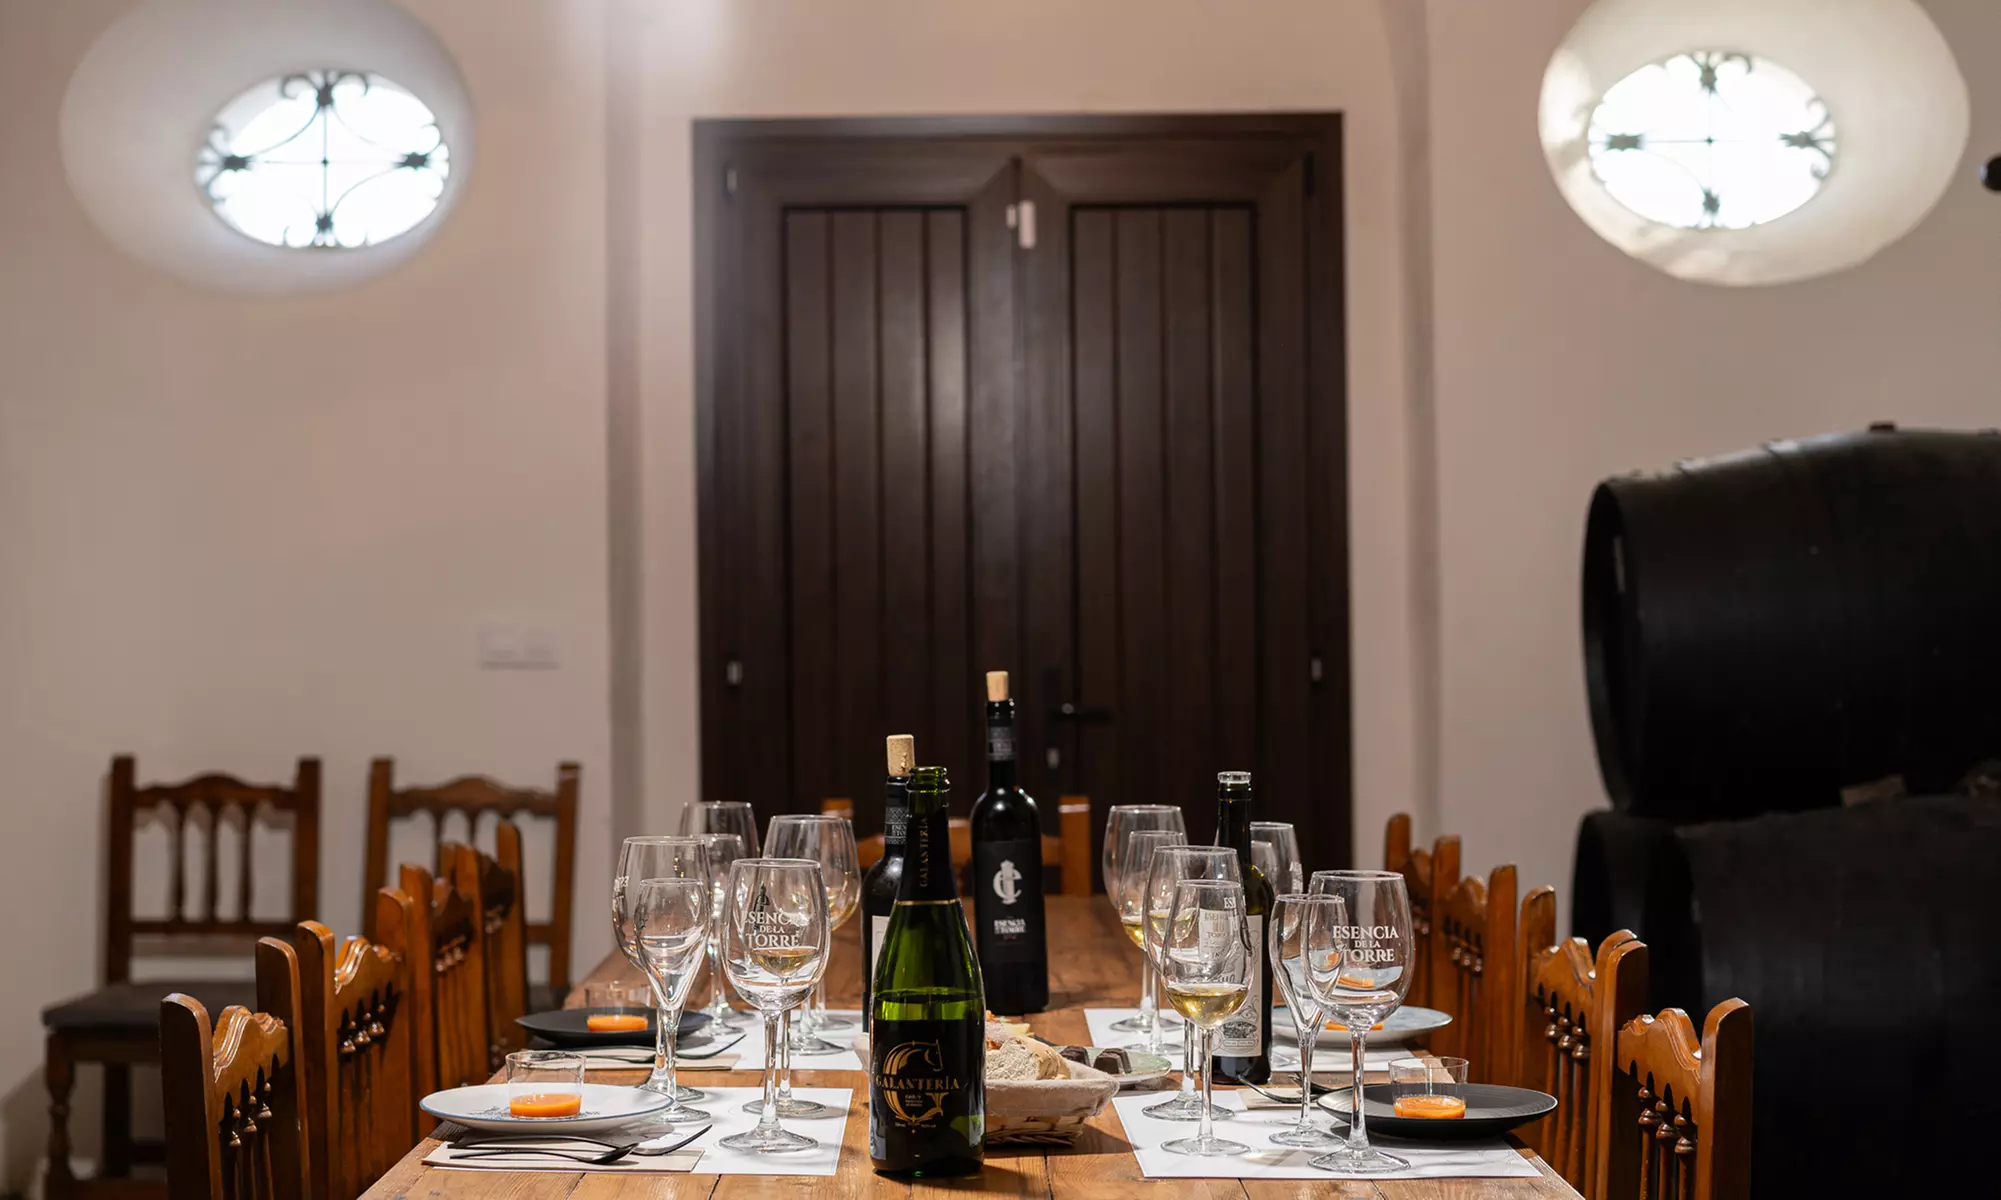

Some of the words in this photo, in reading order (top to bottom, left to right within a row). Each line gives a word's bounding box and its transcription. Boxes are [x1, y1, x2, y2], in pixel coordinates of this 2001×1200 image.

[760, 925, 771, 933] DE
[773, 926, 785, 934] LA
[1333, 925, 1399, 940] ESENCIA
[745, 932, 799, 949] TORRE
[1354, 940, 1367, 948] DE
[1368, 940, 1381, 948] LA
[1342, 948, 1395, 965] TORRE
